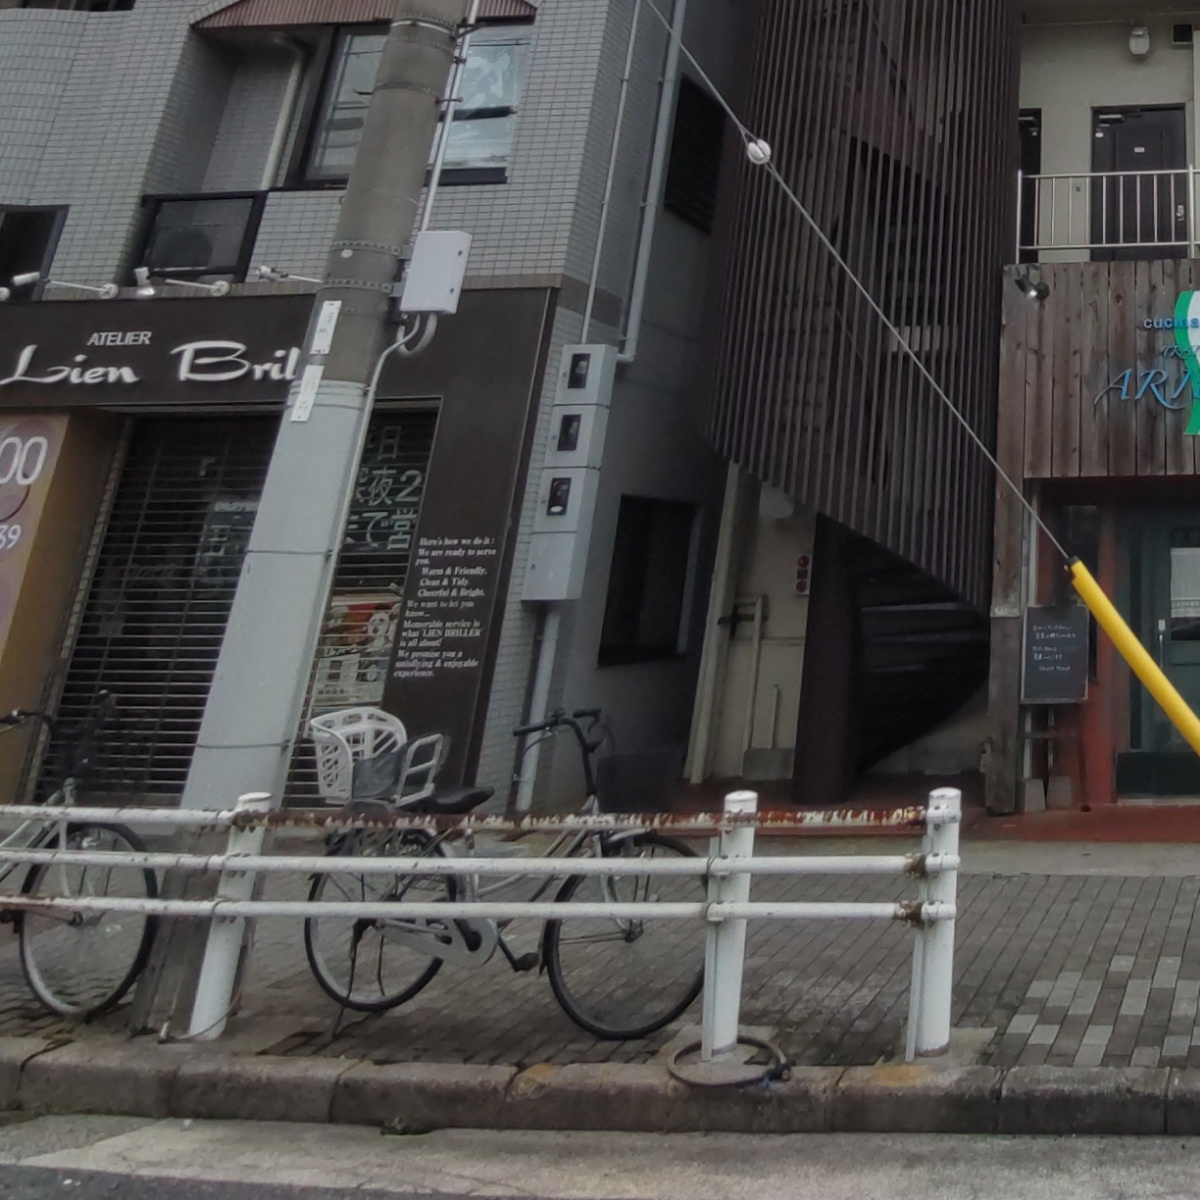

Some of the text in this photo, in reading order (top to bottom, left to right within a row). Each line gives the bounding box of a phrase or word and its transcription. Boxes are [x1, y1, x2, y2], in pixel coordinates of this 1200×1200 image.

[1143, 315, 1200, 329] cucina
[87, 331, 152, 346] ATELIER
[0, 344, 140, 385] Lien
